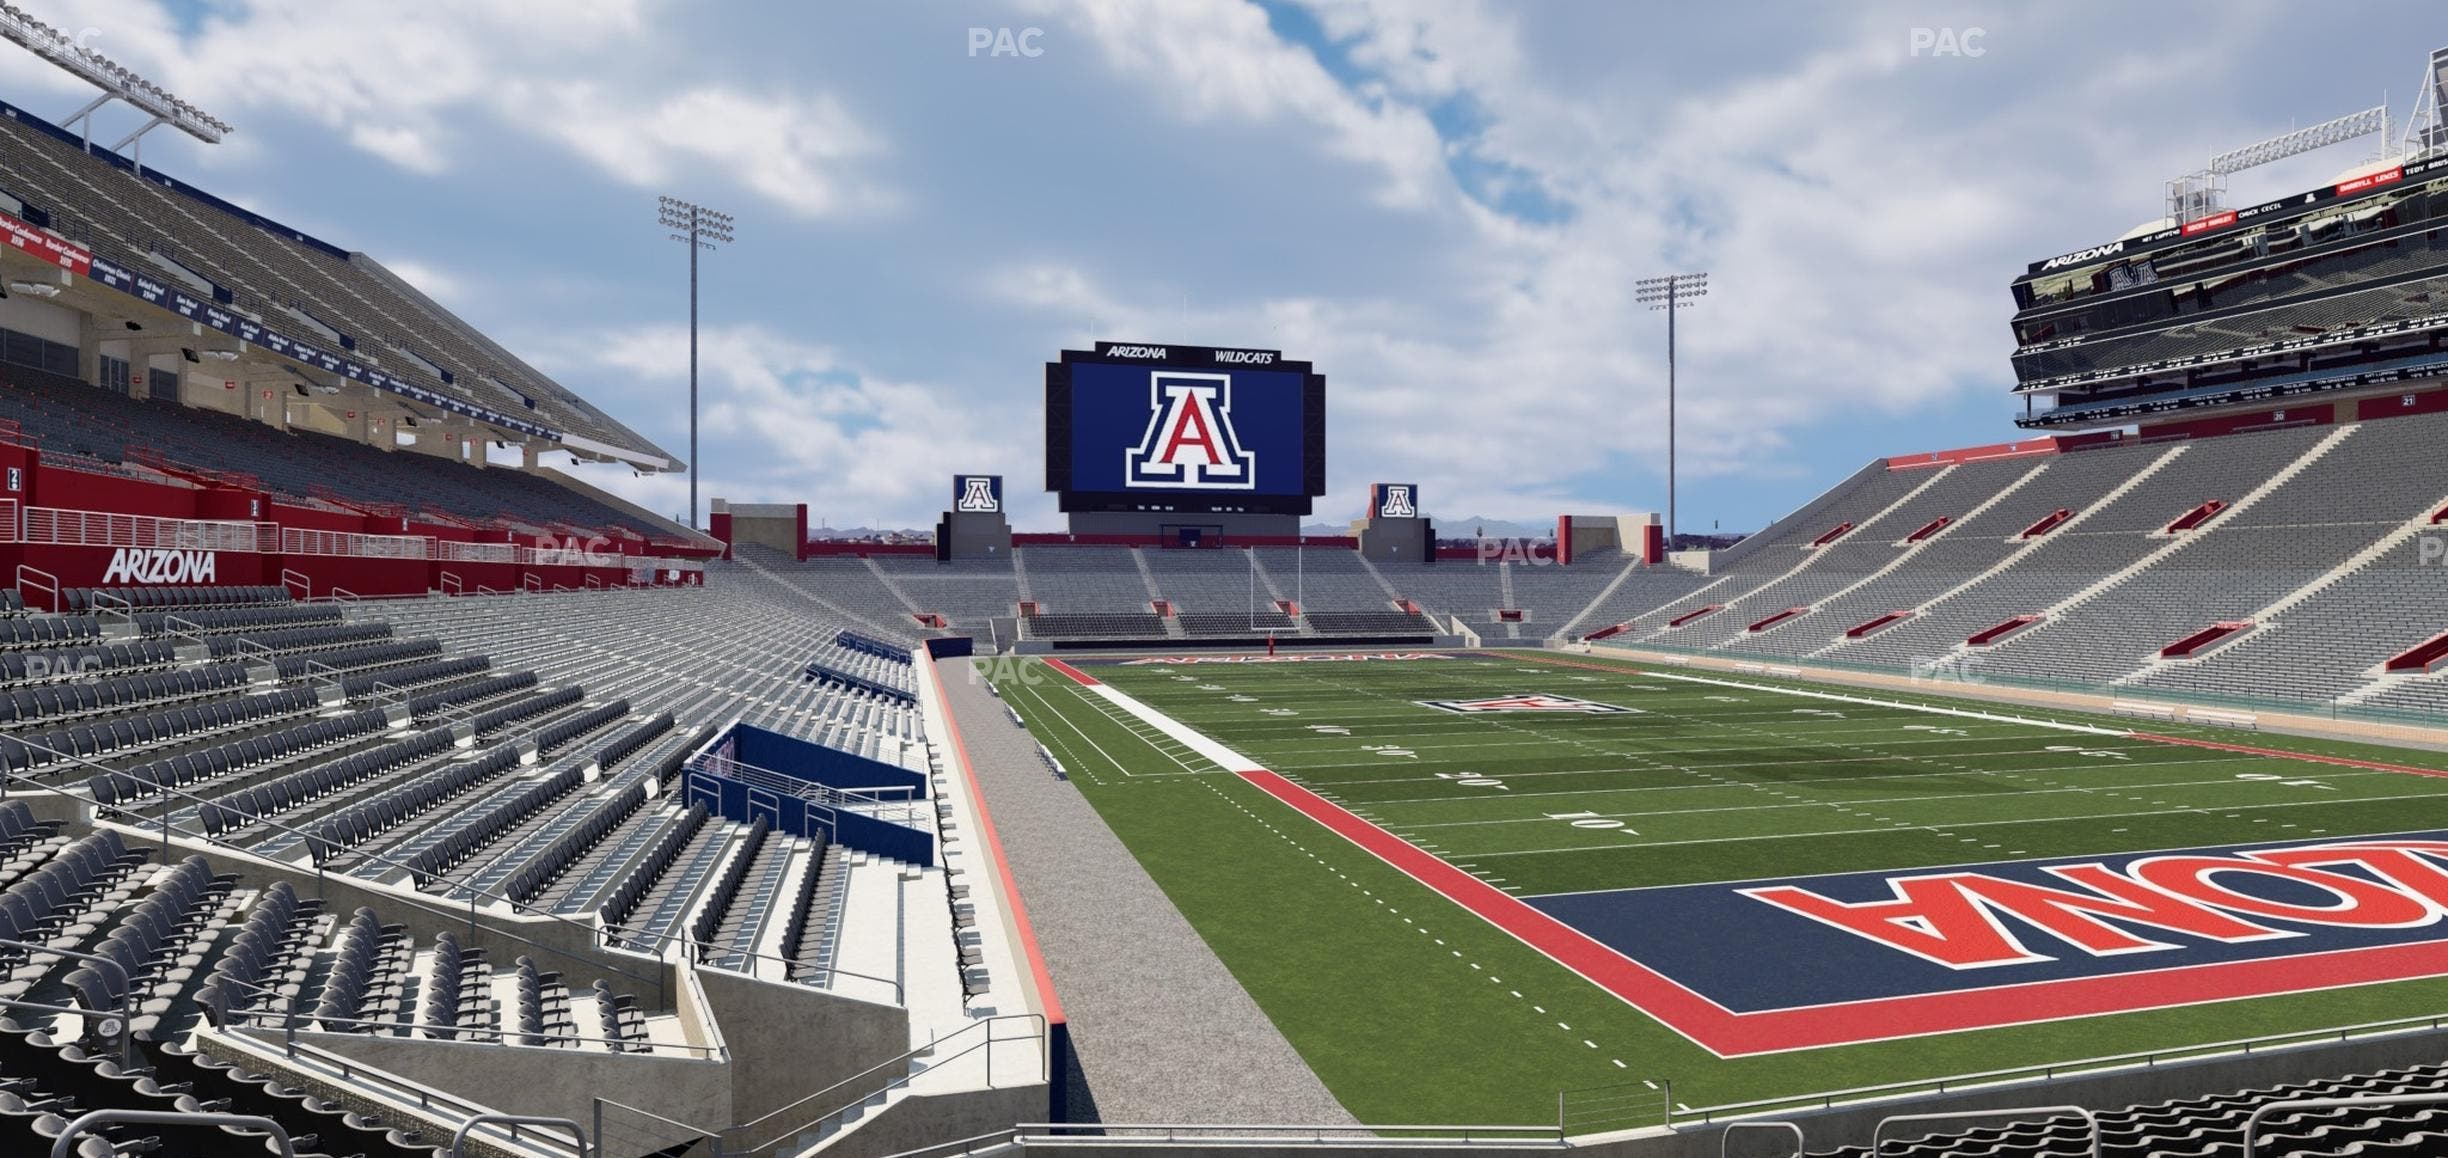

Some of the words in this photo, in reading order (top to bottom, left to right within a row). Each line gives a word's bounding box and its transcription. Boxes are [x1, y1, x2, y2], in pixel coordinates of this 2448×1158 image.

[2041, 242, 2124, 271] ARIZONA
[1107, 346, 1167, 360] ARIZONA
[1215, 350, 1274, 365] WILDCATS
[1126, 371, 1255, 490] A
[958, 477, 998, 512] A
[1382, 486, 1414, 517] A
[102, 548, 216, 583] ARIZONA
[1542, 810, 1625, 829] 10
